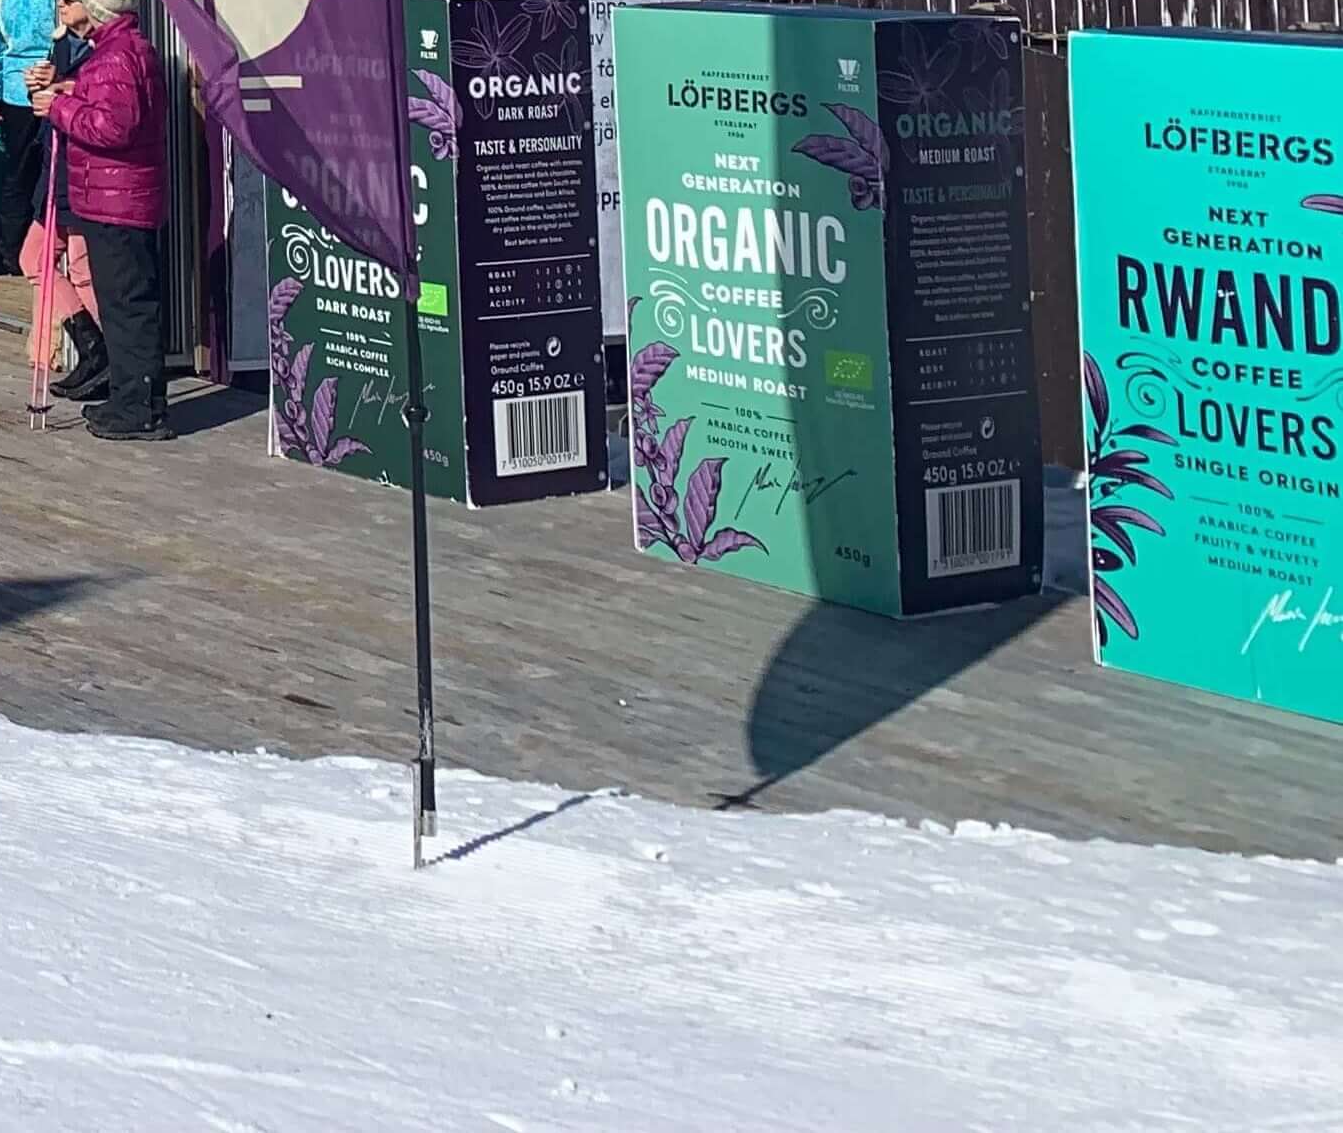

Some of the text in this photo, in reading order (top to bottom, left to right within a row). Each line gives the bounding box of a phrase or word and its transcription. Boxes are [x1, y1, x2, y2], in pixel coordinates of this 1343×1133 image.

[468, 72, 582, 99] ORGANIC
[668, 79, 808, 117] LÖFBERGS
[837, 82, 860, 93] FILTER
[498, 104, 558, 121] DARK ROAST
[896, 110, 1012, 138] ORGANIC
[474, 135, 583, 156] TASTE & PERSONALITY
[1144, 117, 1335, 166] LÖFBERGS
[714, 153, 761, 172] NEXT
[919, 146, 995, 165] MEDIUM ROAST
[681, 172, 800, 198] GENERATION
[903, 187, 934, 204] TASTE
[1208, 206, 1269, 228] NEXT
[646, 197, 847, 284] ORGANIC
[1163, 227, 1323, 261] GENERATION
[311, 248, 400, 299] LOVERS
[490, 298, 525, 308] ACIDITY
[701, 281, 783, 308] COFFEE
[1117, 253, 1342, 356] RWAND
[316, 297, 391, 323] DARK ROAST
[325, 342, 389, 363] ARABICA COFFEE
[690, 314, 807, 368] LOVERS
[326, 356, 346, 367] RICH
[353, 363, 390, 378] COMPLEX
[1192, 356, 1302, 389] COFFEE
[491, 373, 571, 396] 450g 15.9 OZ
[686, 364, 747, 390] MEDIUM
[753, 377, 808, 400] ROAST
[734, 406, 763, 420] 100%
[1173, 386, 1337, 461] LOVERS
[707, 418, 794, 444] ARABICA COFFEE
[707, 434, 749, 452] SMOOTH
[751, 443, 758, 454] &
[923, 458, 1005, 485] 450g 15.9 OZ
[1174, 453, 1340, 498] SINGLE ORIGIN
[1238, 503, 1275, 519] 100%
[1199, 515, 1315, 548] ARABICA COFFEE
[835, 545, 871, 568] 450g
[1195, 533, 1319, 568] FRUITY & VELVETY
[1208, 555, 1313, 587] MEDIUM ROAST
